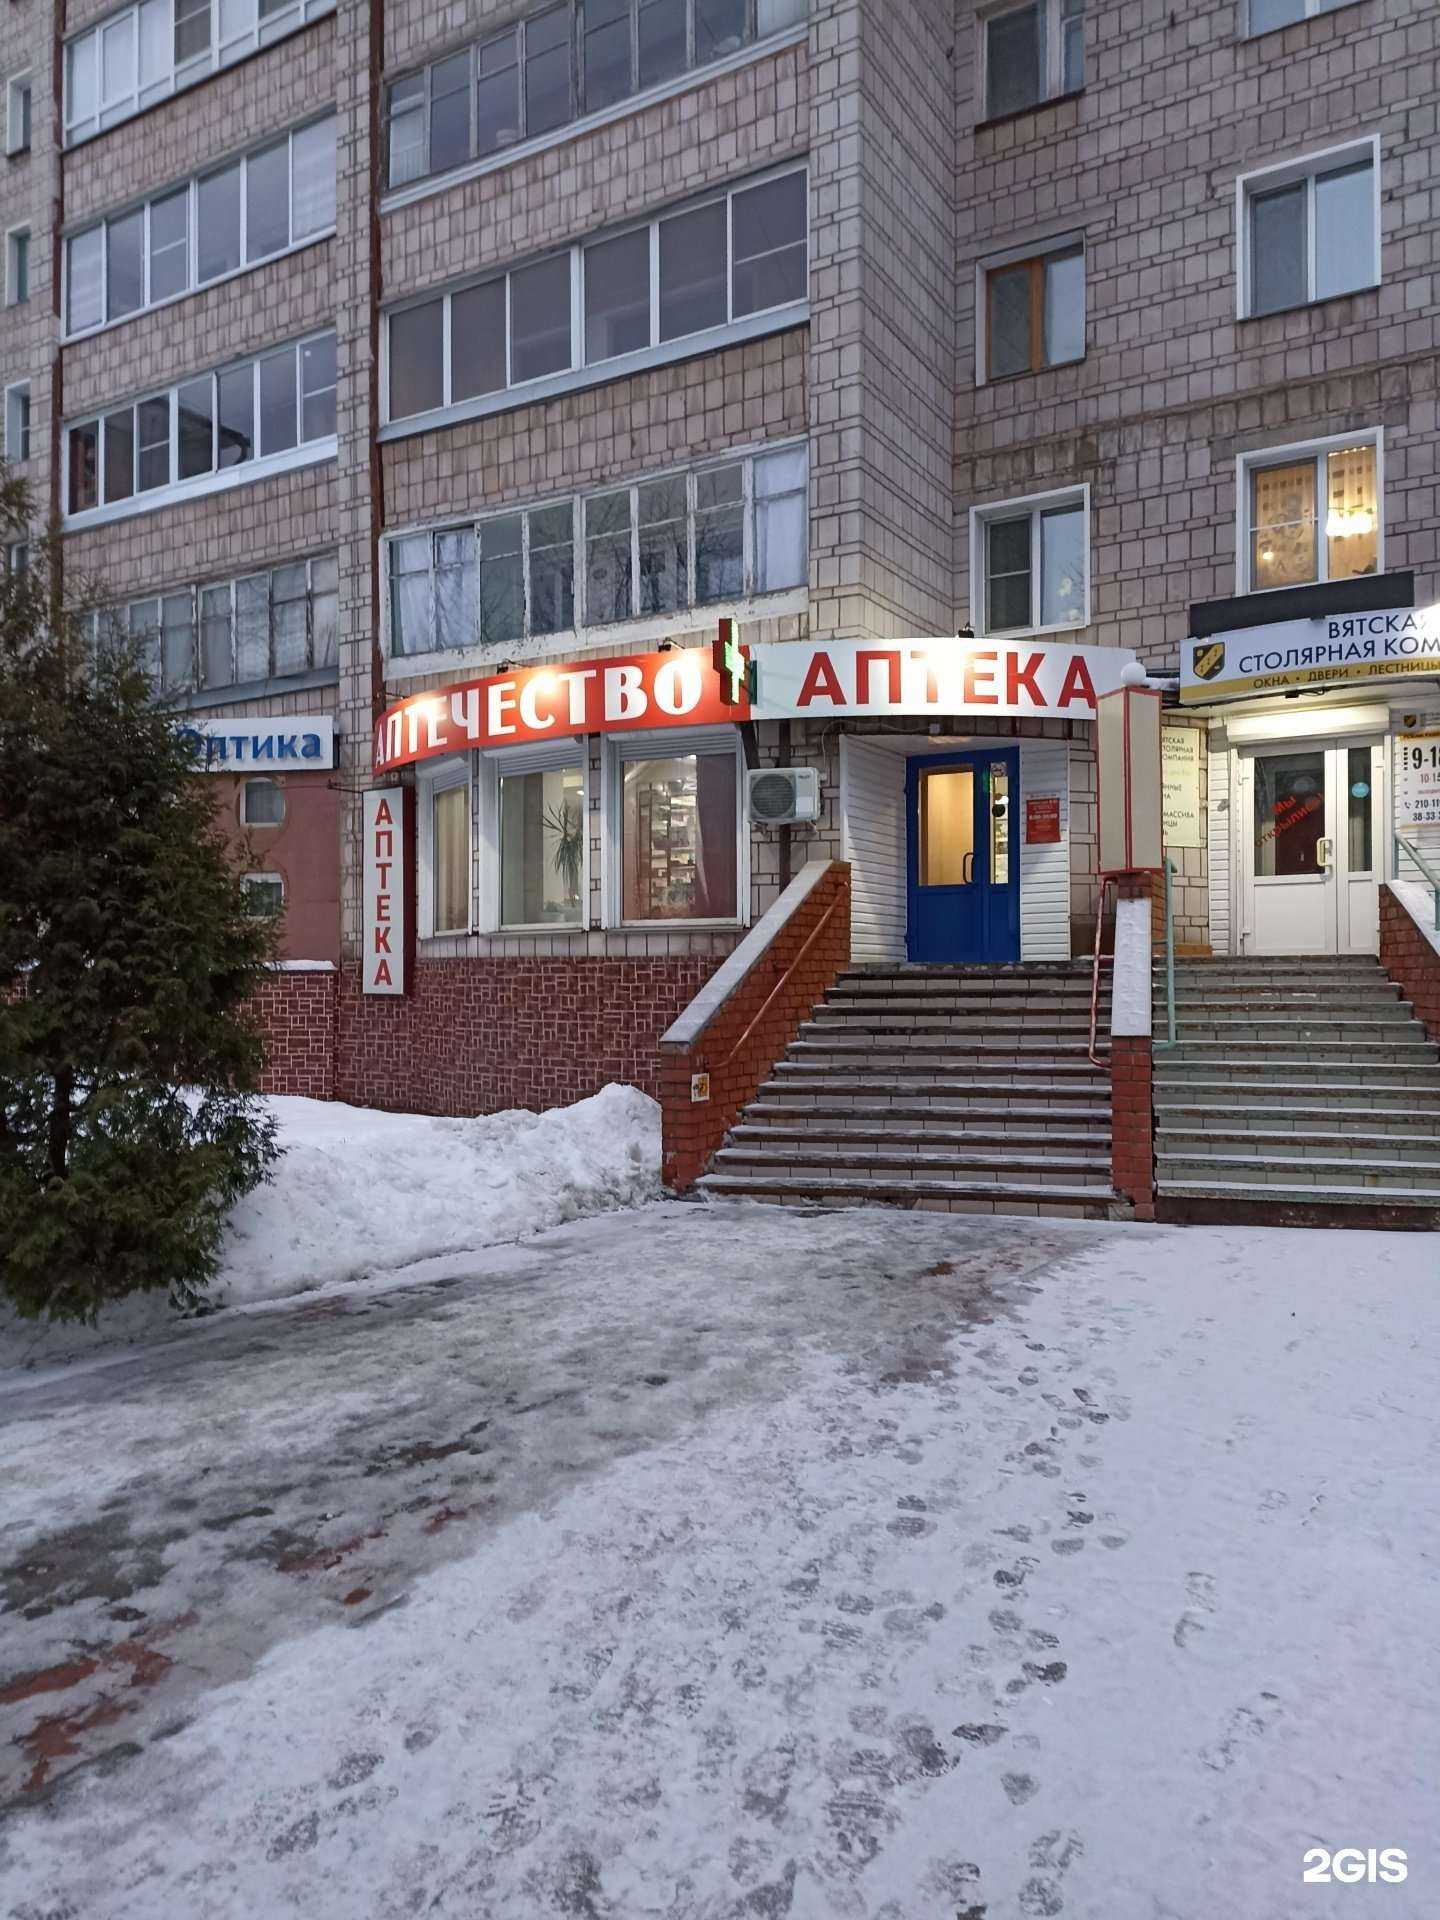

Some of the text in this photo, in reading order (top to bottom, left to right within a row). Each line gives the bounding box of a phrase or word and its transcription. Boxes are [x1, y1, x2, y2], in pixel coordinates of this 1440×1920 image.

[1328, 613, 1427, 639] ВЯТСКА
[1239, 640, 1376, 673] СТОЛЯРНАЯ
[796, 650, 1097, 709] АПТЕКА
[1253, 677, 1290, 689] ОКНА
[1307, 668, 1349, 682] ДВЕРИ
[375, 659, 702, 768] АПТЕЧЕСТВО
[1412, 746, 1440, 770] 9-1
[374, 798, 393, 986] АПТЕКА
